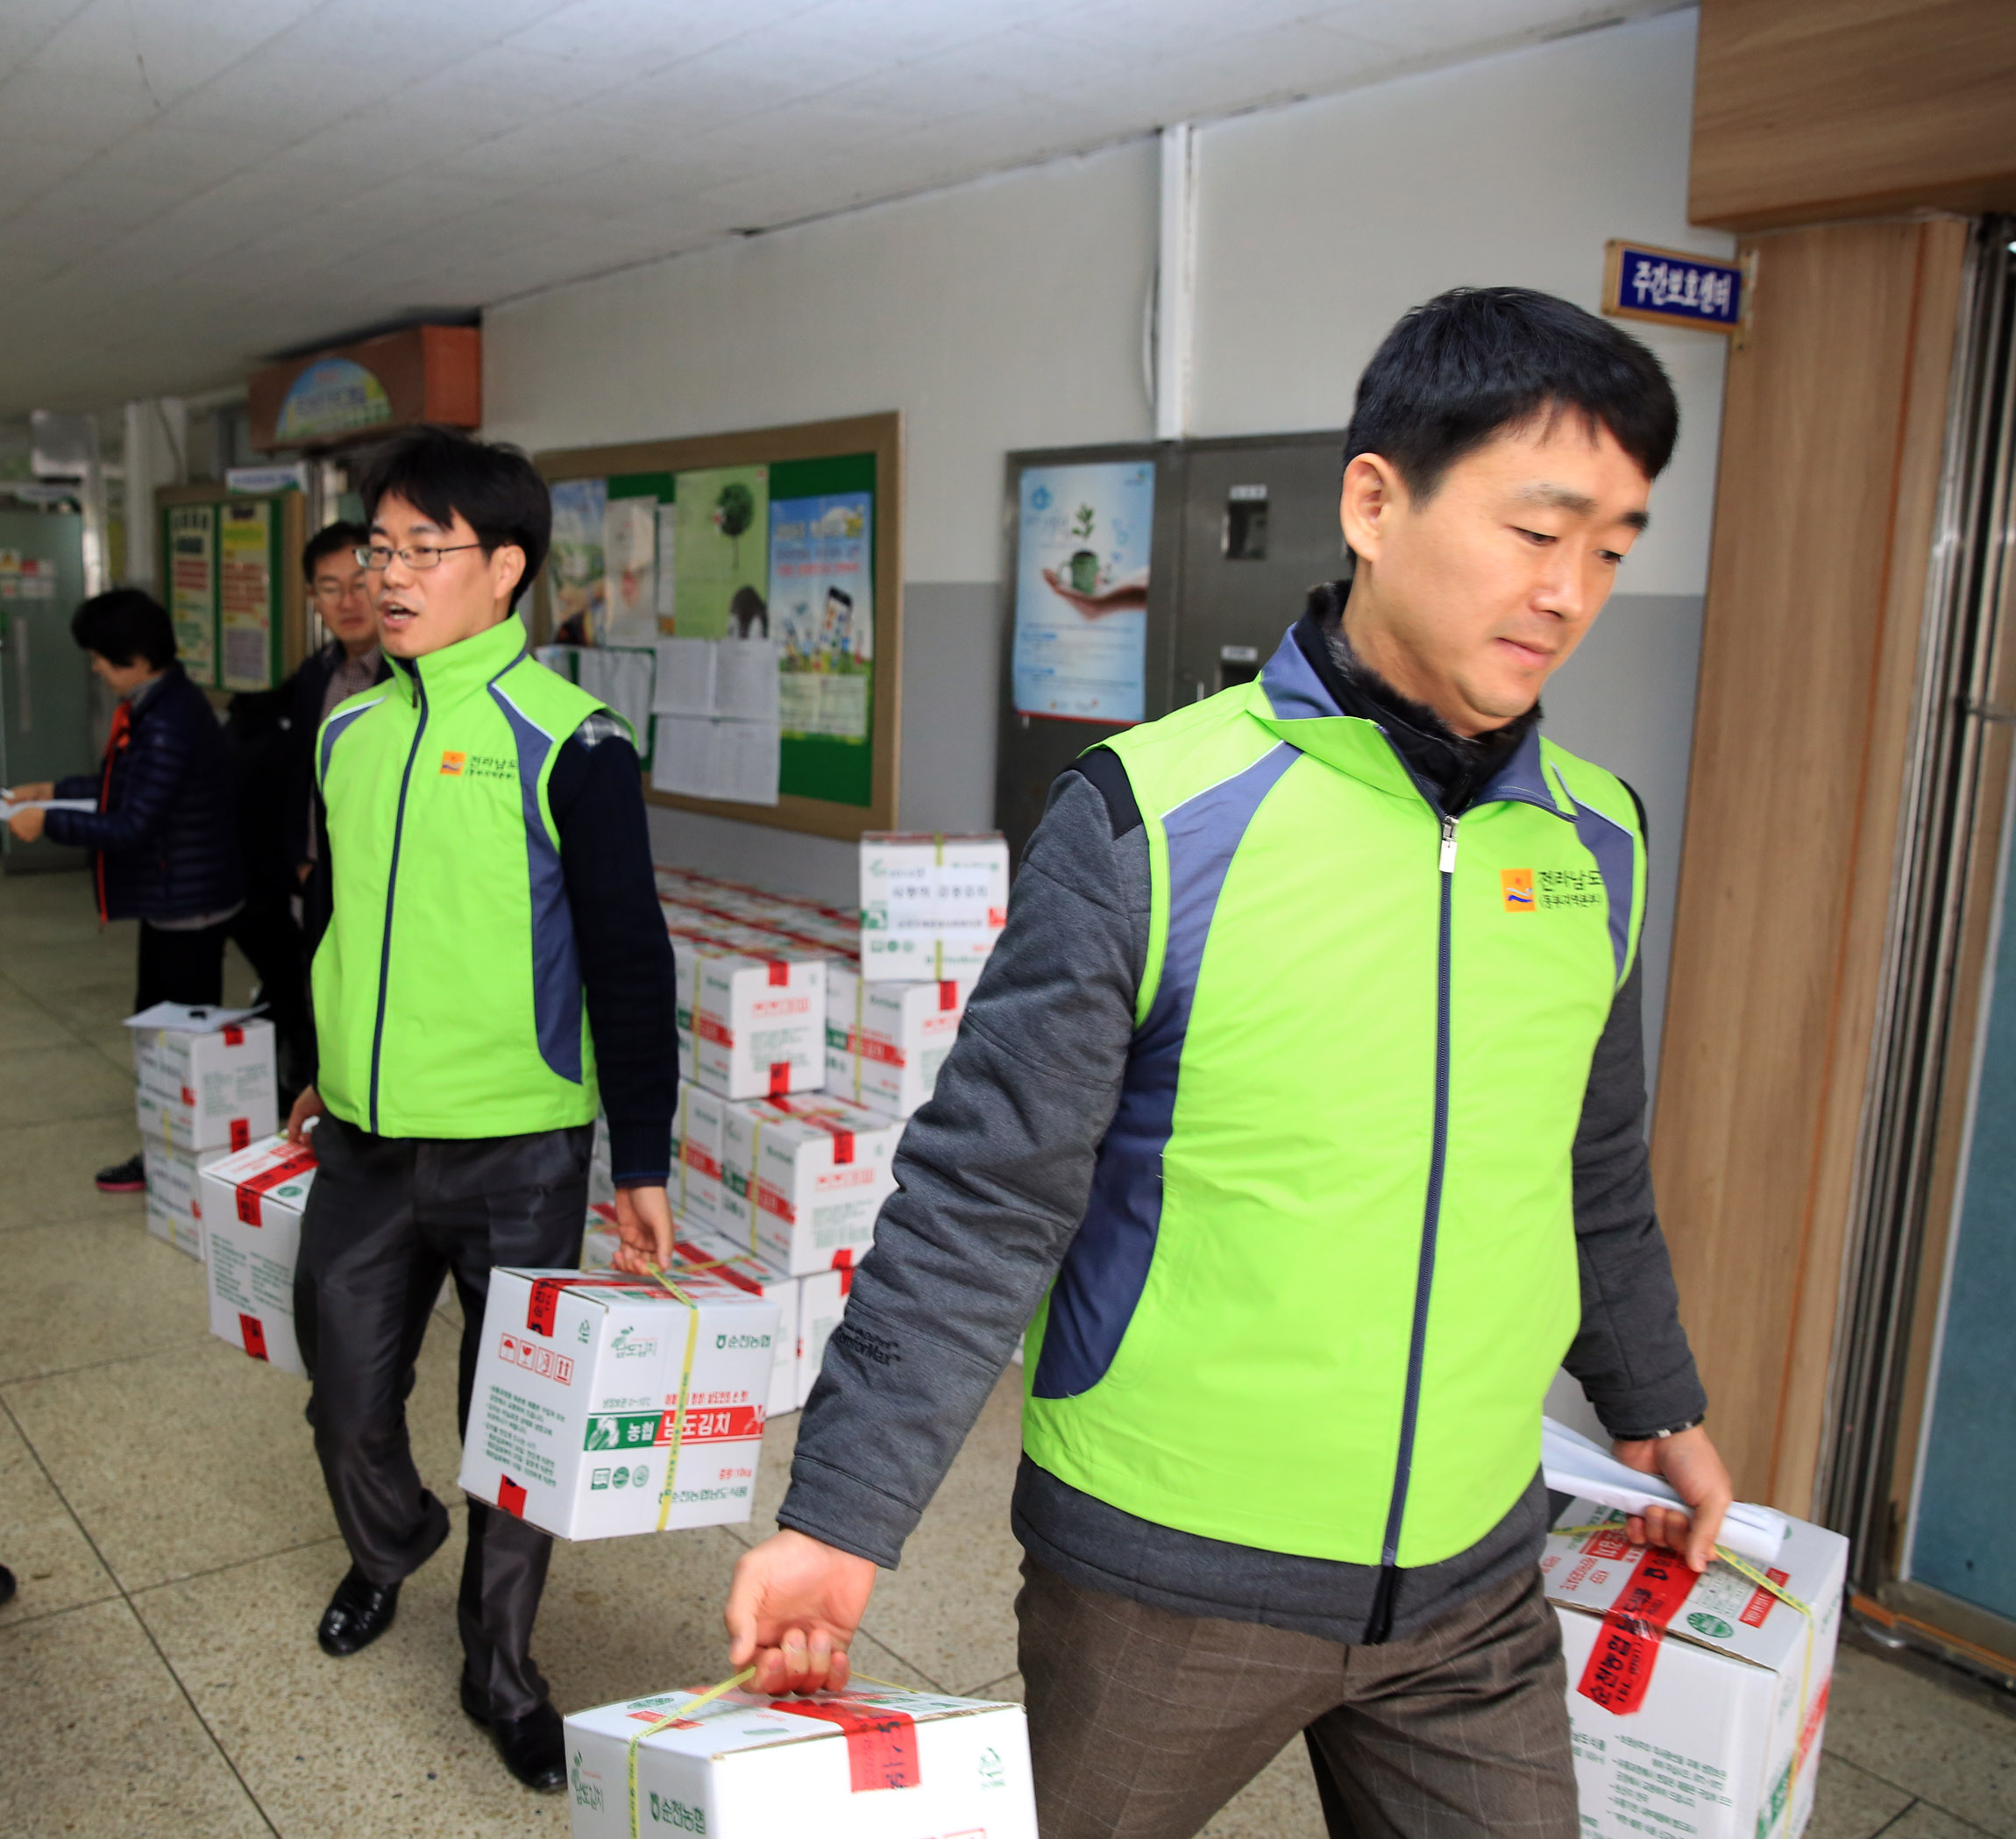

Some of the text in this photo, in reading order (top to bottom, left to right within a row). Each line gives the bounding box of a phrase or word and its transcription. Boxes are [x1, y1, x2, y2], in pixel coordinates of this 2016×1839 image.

[1633, 260, 1732, 317] 주간보호센터
[1538, 870, 1603, 891] 전라남도
[627, 1421, 655, 1442] 농협
[1588, 1633, 1631, 1706] 순천농협
[662, 1796, 706, 1835] 순천농협
